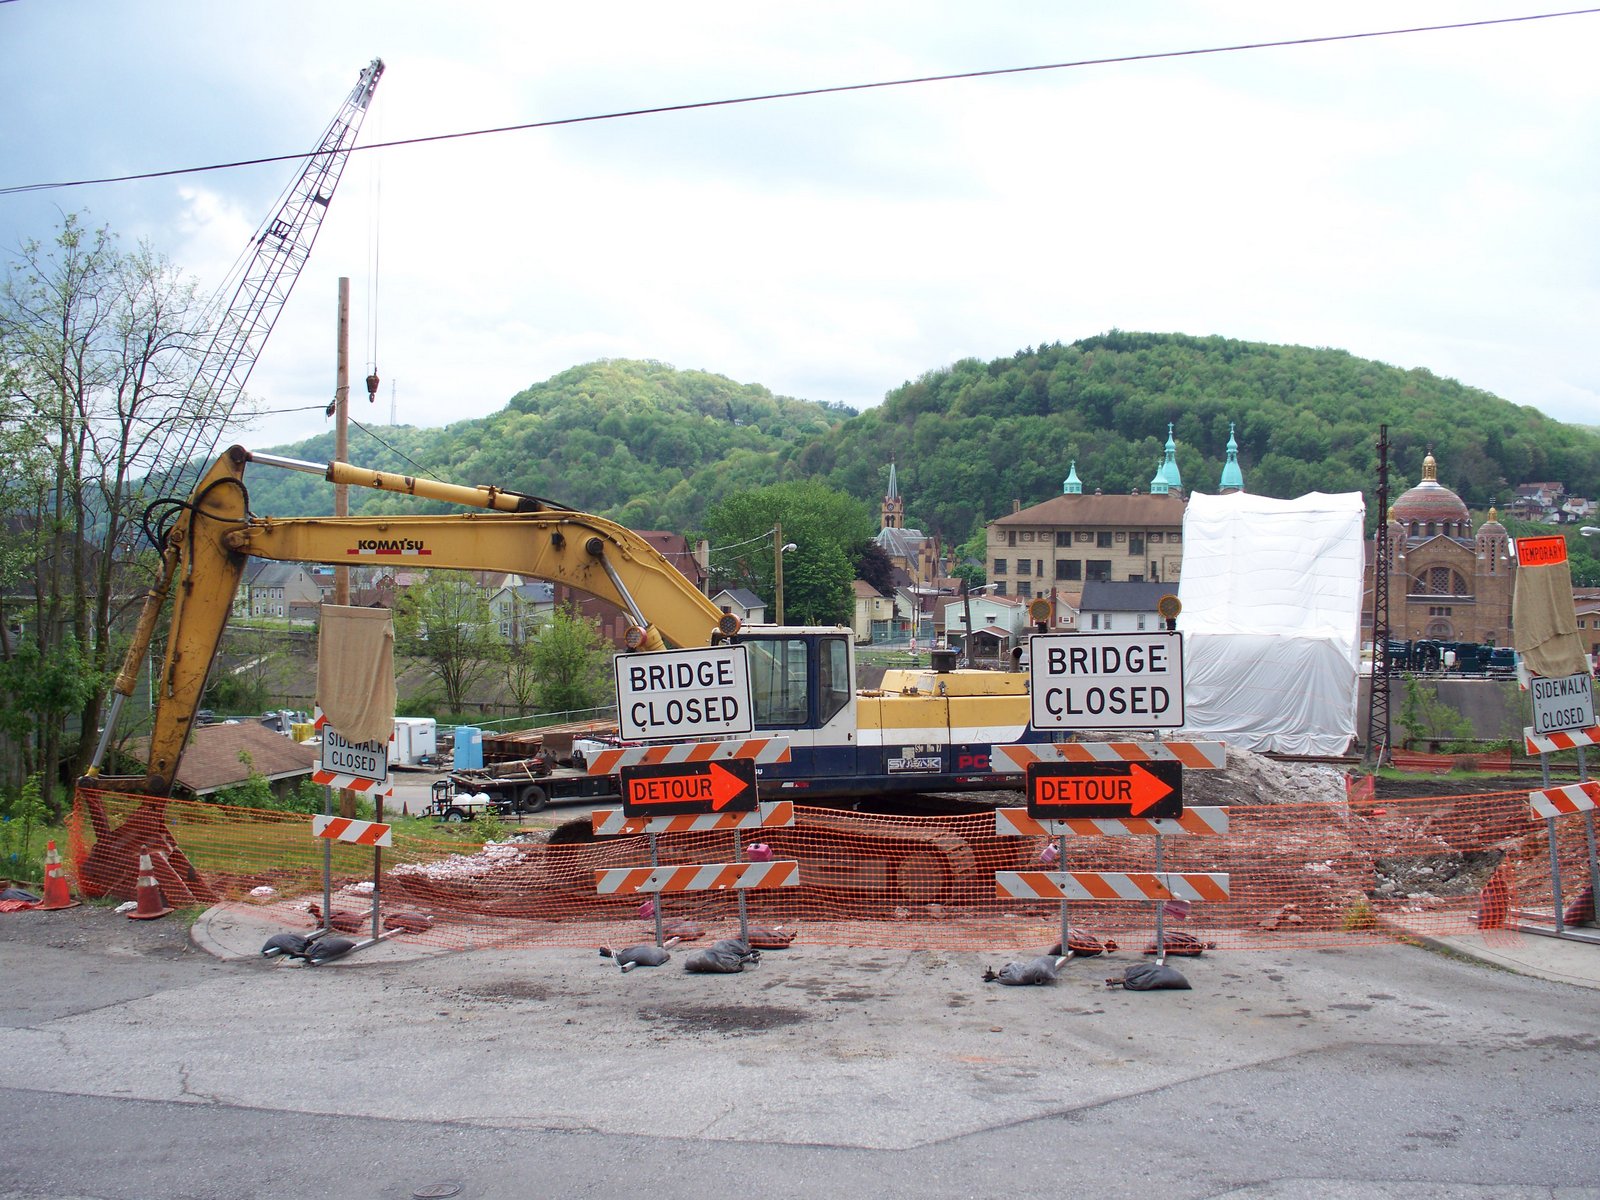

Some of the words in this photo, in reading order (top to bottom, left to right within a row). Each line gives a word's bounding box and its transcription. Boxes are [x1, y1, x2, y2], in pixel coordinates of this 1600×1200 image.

[358, 538, 424, 550] KOMATSU
[1521, 545, 1563, 561] TEMPORARY
[1048, 645, 1167, 675] BRIDGE
[630, 660, 734, 692] BRIDGE
[1535, 676, 1588, 700] SIDEWALK
[631, 696, 739, 727] CLOSED
[1045, 686, 1170, 715] CLOSED
[1542, 707, 1584, 729] CLOSED
[332, 751, 376, 772] CLOSED
[634, 778, 713, 801] DETOUR
[1041, 780, 1132, 801] DETOUR
